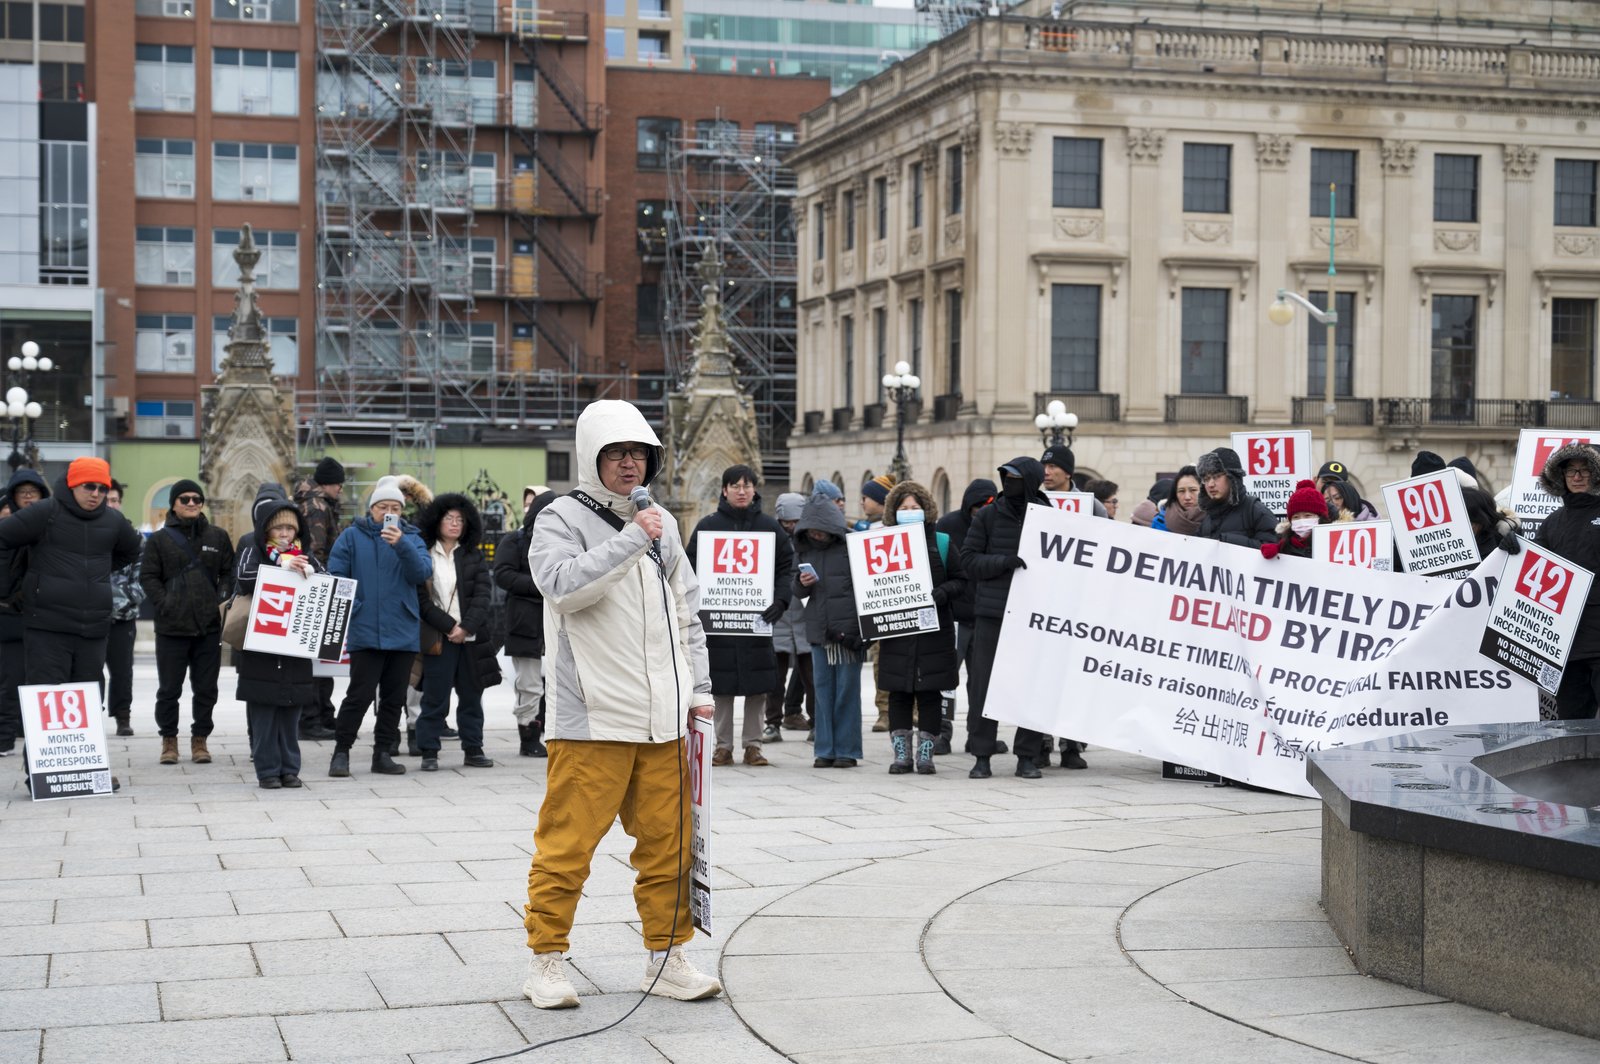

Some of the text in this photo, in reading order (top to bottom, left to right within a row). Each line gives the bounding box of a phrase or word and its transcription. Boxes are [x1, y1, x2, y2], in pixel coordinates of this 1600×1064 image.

[1254, 438, 1289, 474] 31
[1254, 480, 1290, 488] MONTHS
[577, 493, 602, 511] SONY
[1404, 483, 1445, 528] 90
[1515, 505, 1536, 513] IRCC
[1522, 521, 1533, 529] NO
[1416, 528, 1451, 545] MONTHS
[718, 539, 754, 574] 43
[869, 533, 908, 574] 54
[1334, 530, 1372, 569] 40
[1410, 538, 1464, 559] WAITING FOR
[1409, 550, 1473, 572] IRCC RESPONSE
[717, 578, 753, 586] MONTHS
[874, 574, 910, 586] MONTHS
[1040, 531, 1098, 568] WE
[1106, 546, 1233, 596] DEMAND
[1236, 573, 1245, 602] A
[1253, 576, 1384, 625] TIMELY
[1522, 556, 1566, 610] 42
[708, 588, 743, 596] WAITING
[863, 593, 928, 610] IRCC RESPONSE
[866, 583, 921, 599] WAITING FOR
[257, 590, 293, 628] 14
[702, 598, 767, 607] IRCC RESPONSE
[1515, 599, 1554, 627] MONTHS
[292, 595, 306, 634] MONTHS
[300, 586, 318, 645] WAITING FOR
[308, 582, 329, 652] IRCC RESPONSE
[324, 598, 339, 646] NO TIMELINE
[335, 598, 347, 631] RESULTS
[721, 612, 754, 621] TIMELINE
[724, 621, 754, 629] RESULTS
[873, 611, 918, 624] NO TIMELINE
[1169, 595, 1272, 642] DELAYED
[1280, 619, 1332, 654] BY
[1503, 606, 1560, 644] WAITING FOR
[332, 632, 340, 643] NO
[877, 620, 920, 633] NO RESULTS
[1494, 615, 1562, 659] IRCC RESPONSE
[1029, 612, 1182, 660] REASONABLE
[1388, 670, 1512, 690] FAIRNESS
[1497, 637, 1543, 668] NO TIMELINE
[1497, 649, 1541, 678] NO RESULTS
[1082, 656, 1153, 686] Délais
[1158, 677, 1259, 710] raisonnables
[44, 690, 82, 729] 18
[48, 733, 85, 744] MONTHS
[1173, 707, 1249, 748] 给出时限
[40, 744, 96, 756] WAITING FOR
[36, 755, 102, 768] IRCC RESPONSE
[1174, 766, 1208, 777] NO RESULTS
[46, 772, 92, 784] NO TIMELINE
[51, 782, 94, 793] NO RESULTS
